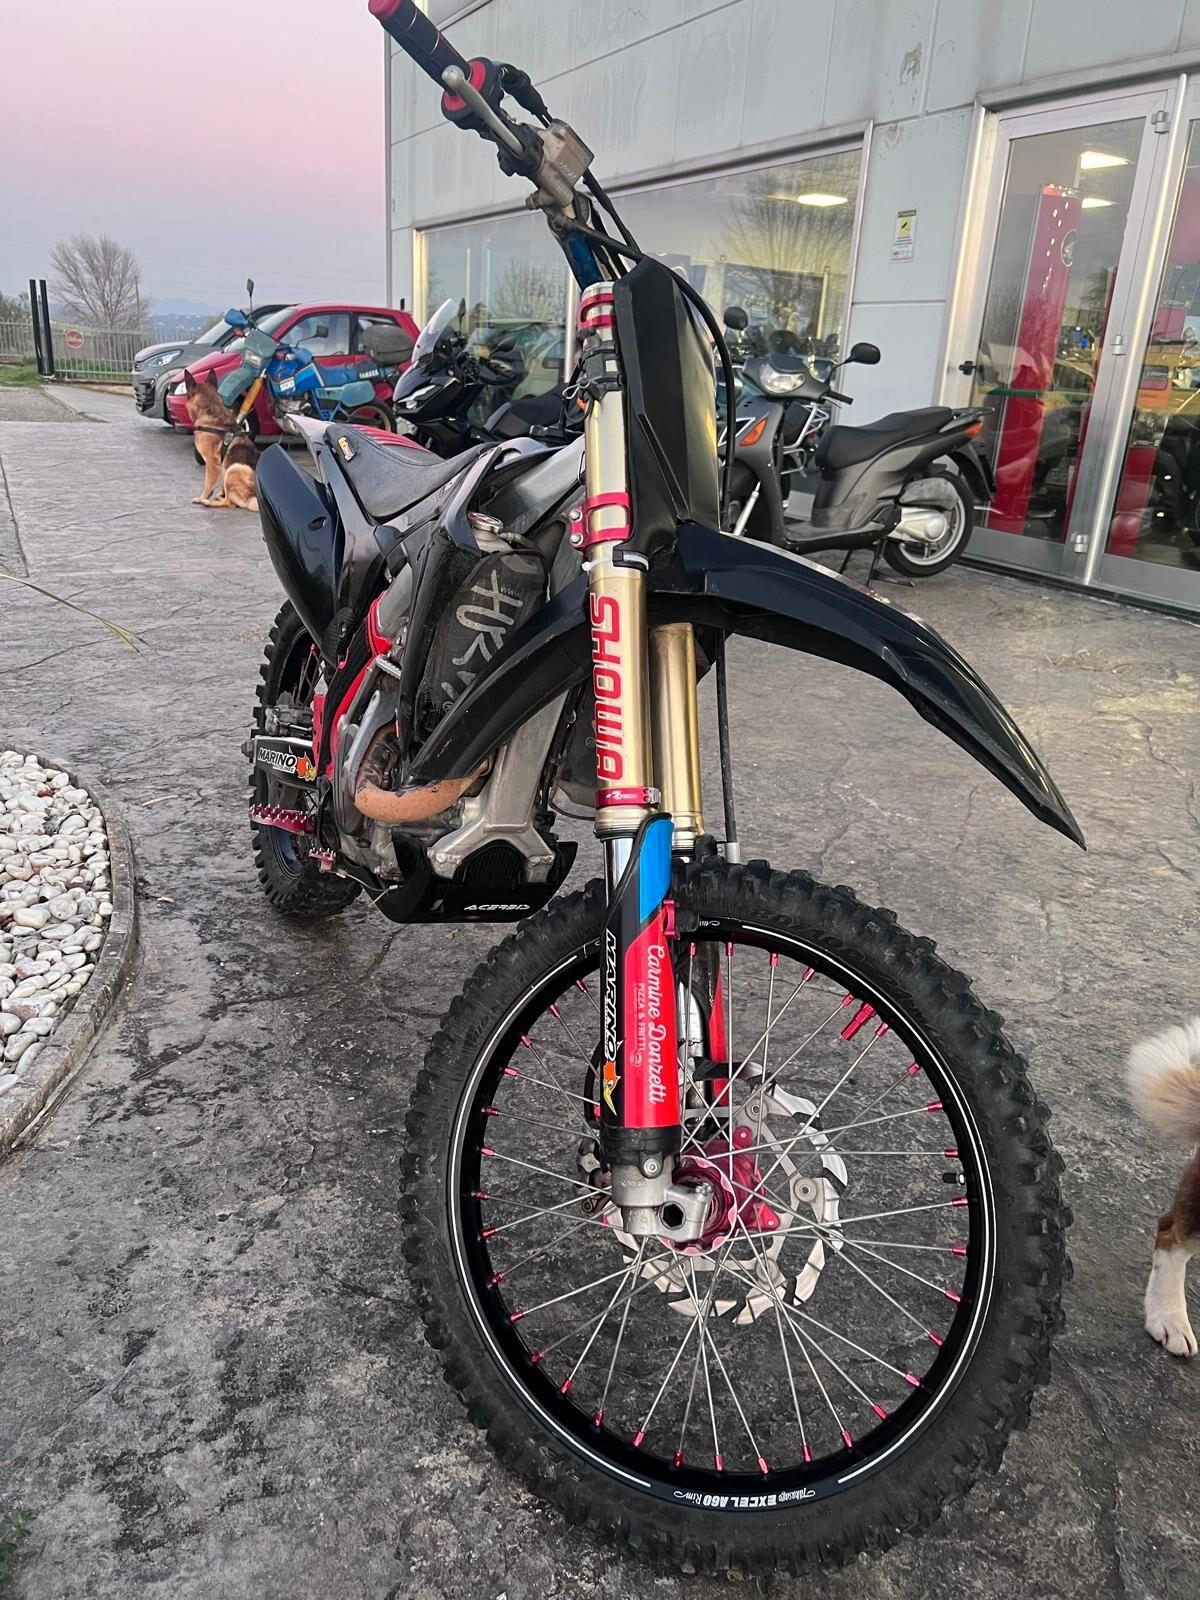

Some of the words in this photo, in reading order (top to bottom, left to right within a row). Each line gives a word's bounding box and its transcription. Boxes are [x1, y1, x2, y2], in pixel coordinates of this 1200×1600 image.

[590, 593, 624, 782] SHOWA
[258, 748, 297, 768] MARINO
[605, 928, 617, 1062] MARINO
[648, 944, 666, 1018] Carmine
[648, 1022, 667, 1104] Donzetti
[703, 1494, 729, 1507] A60
[730, 1495, 777, 1508] EXCEL
